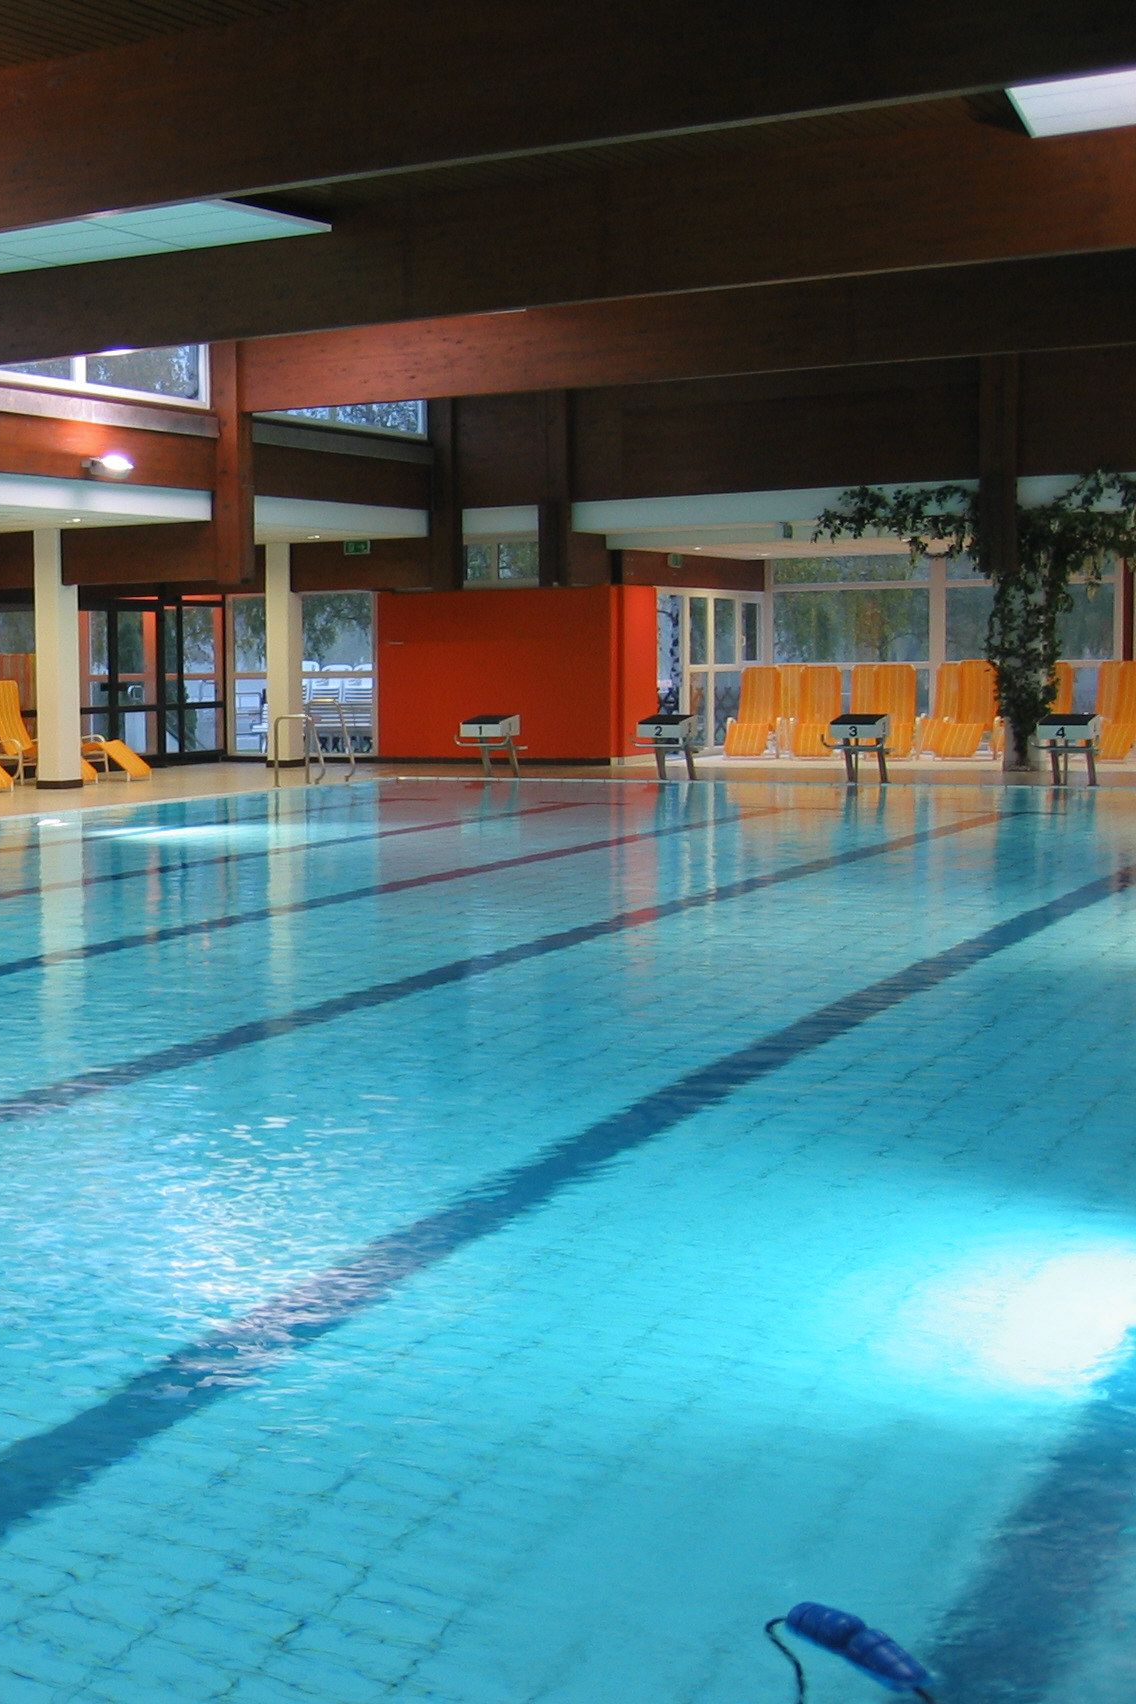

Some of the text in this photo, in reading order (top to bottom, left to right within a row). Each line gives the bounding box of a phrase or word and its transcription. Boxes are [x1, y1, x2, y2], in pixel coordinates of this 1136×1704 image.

[478, 725, 483, 736] 1
[654, 725, 663, 737] 2
[848, 725, 858, 737] 3
[1055, 726, 1066, 738] 4
